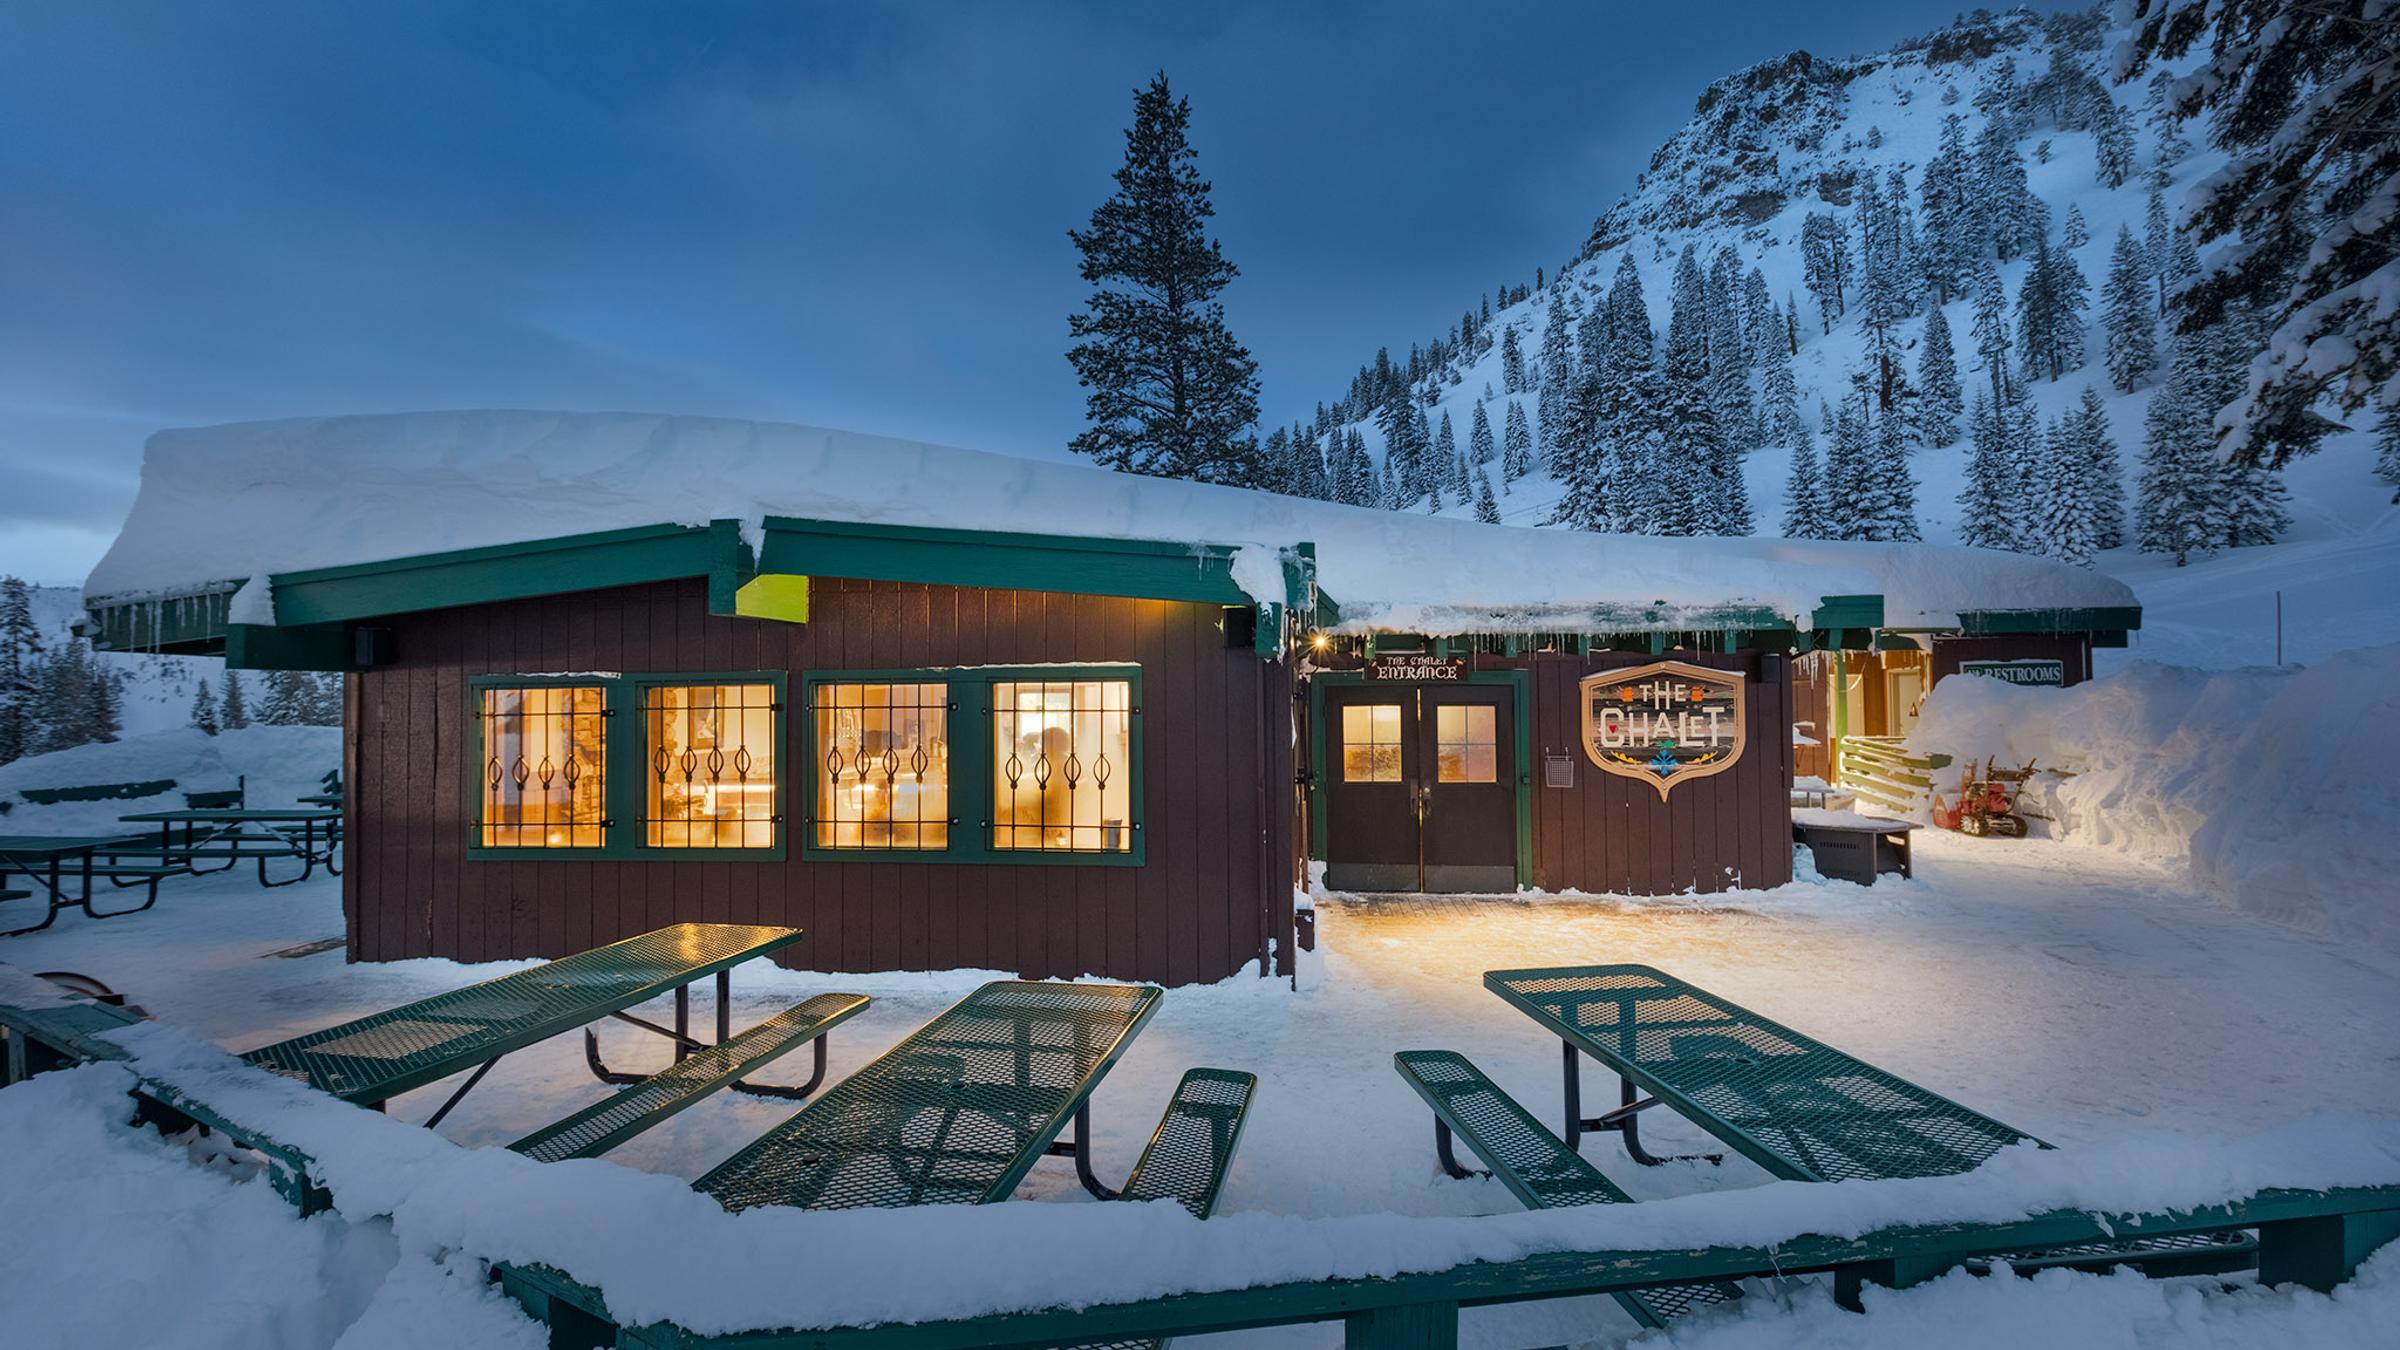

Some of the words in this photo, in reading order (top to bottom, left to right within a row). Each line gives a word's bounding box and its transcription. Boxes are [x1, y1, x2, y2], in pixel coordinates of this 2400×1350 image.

[1386, 656, 1405, 666] THE
[1409, 656, 1448, 666] CHALET
[1377, 665, 1457, 680] ENTRANCE
[1639, 681, 1687, 710] THE
[1600, 706, 1725, 748] CHALET
